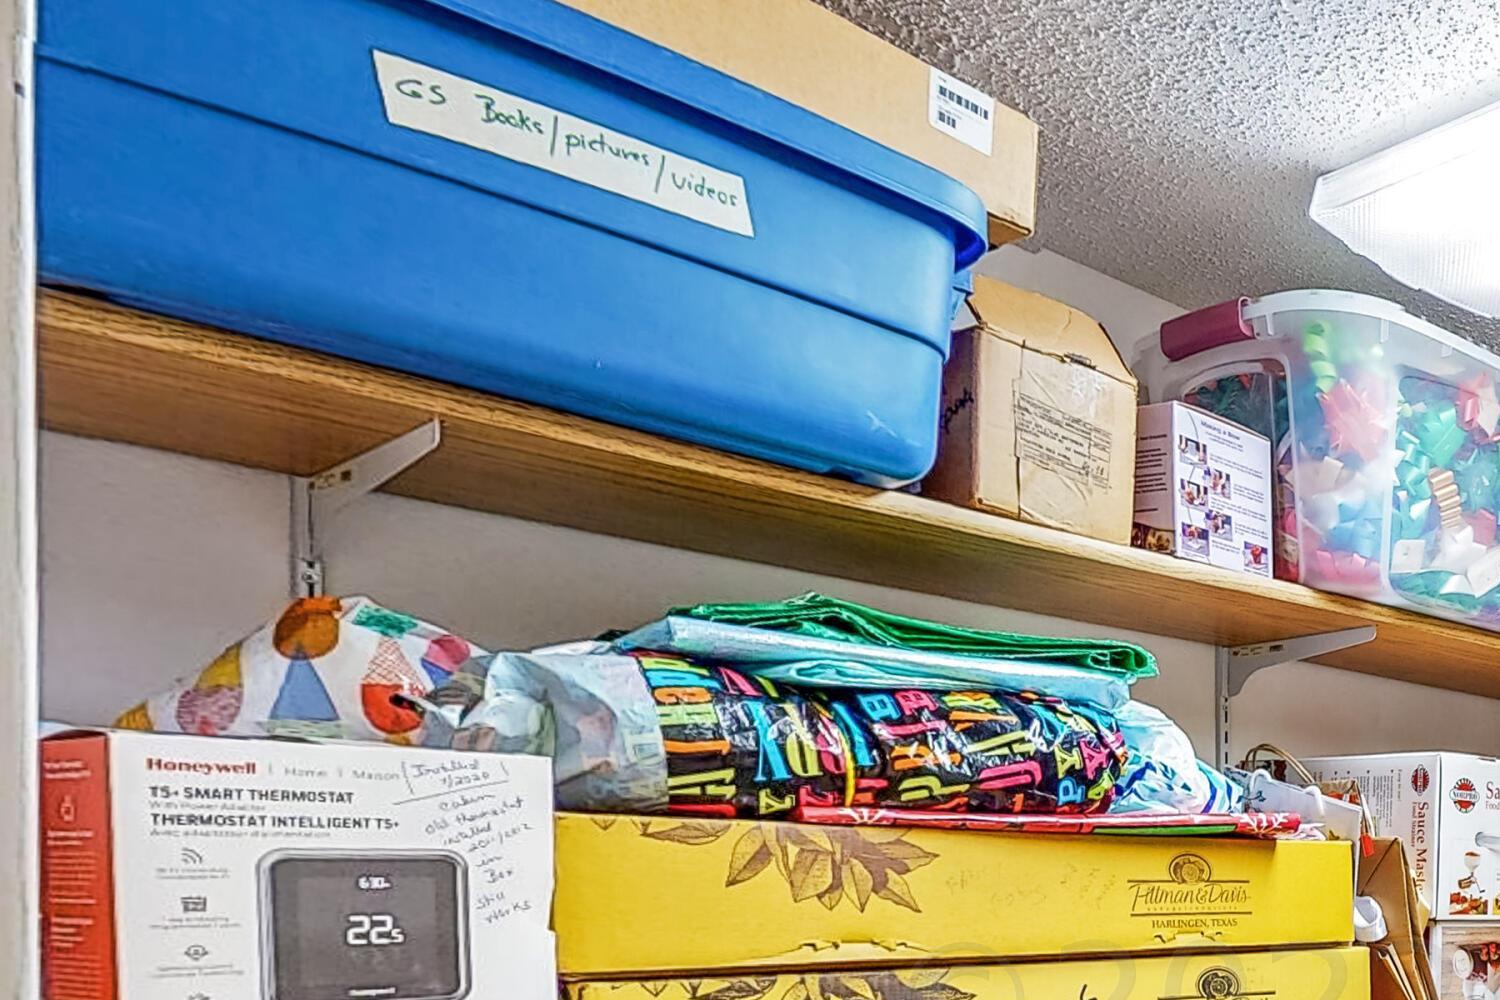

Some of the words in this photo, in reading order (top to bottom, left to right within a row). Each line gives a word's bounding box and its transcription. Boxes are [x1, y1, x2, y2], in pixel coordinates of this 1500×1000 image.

[146, 757, 257, 775] Honeywell
[184, 787, 244, 800] SMART
[250, 788, 354, 804] THERMOSTAT
[1485, 801, 1500, 811] Food
[150, 812, 268, 828] THERMOSTAT
[271, 814, 370, 829] INTELLIGENT
[1417, 801, 1429, 844] Sauce
[1152, 919, 1210, 930] HARLINGEN,
[1212, 918, 1238, 928] TEXAS
